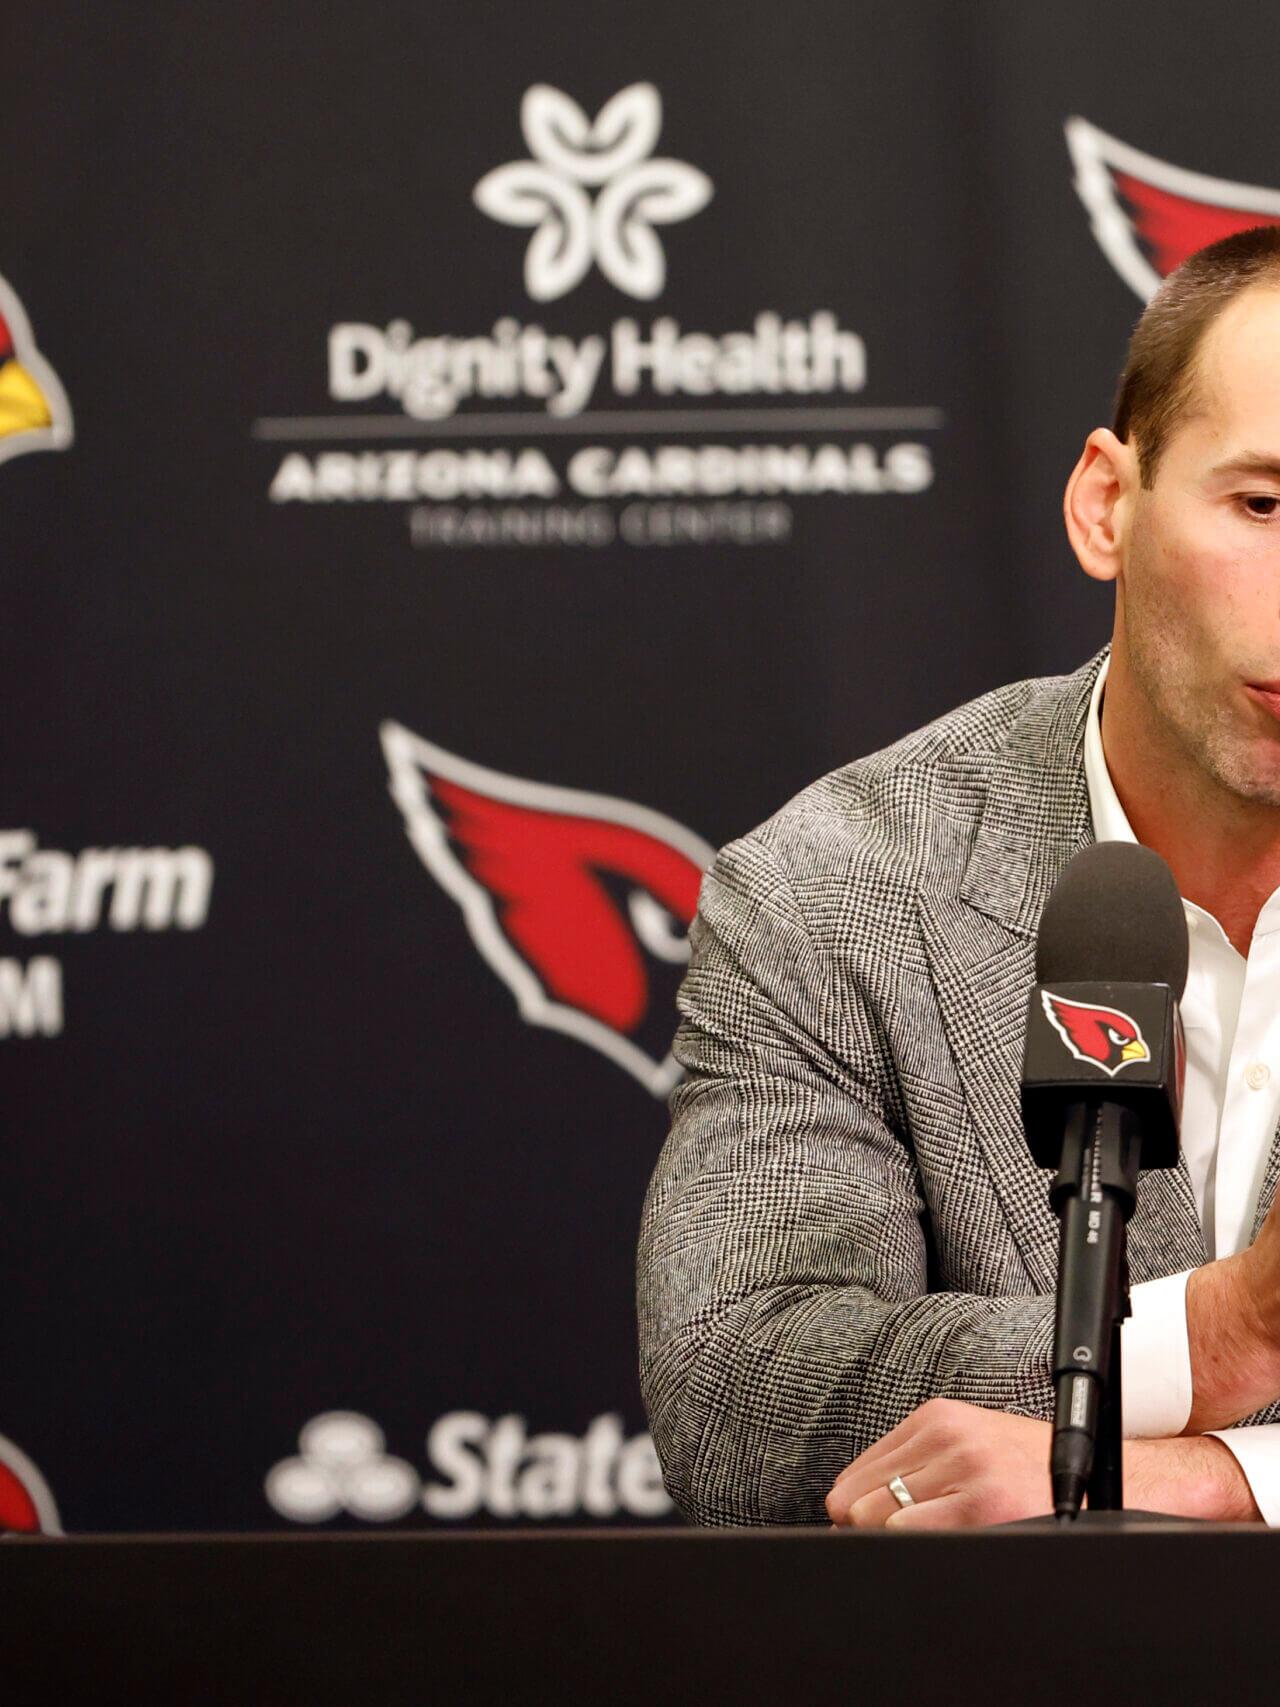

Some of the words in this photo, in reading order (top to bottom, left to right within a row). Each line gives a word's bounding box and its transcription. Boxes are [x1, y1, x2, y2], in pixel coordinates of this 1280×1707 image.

[328, 318, 604, 421] Dignity
[611, 311, 866, 394] Health
[269, 448, 559, 501] ARIZONA
[567, 443, 932, 496] CARDINALS
[409, 501, 615, 548] TRAINING
[618, 500, 793, 546] CENTER
